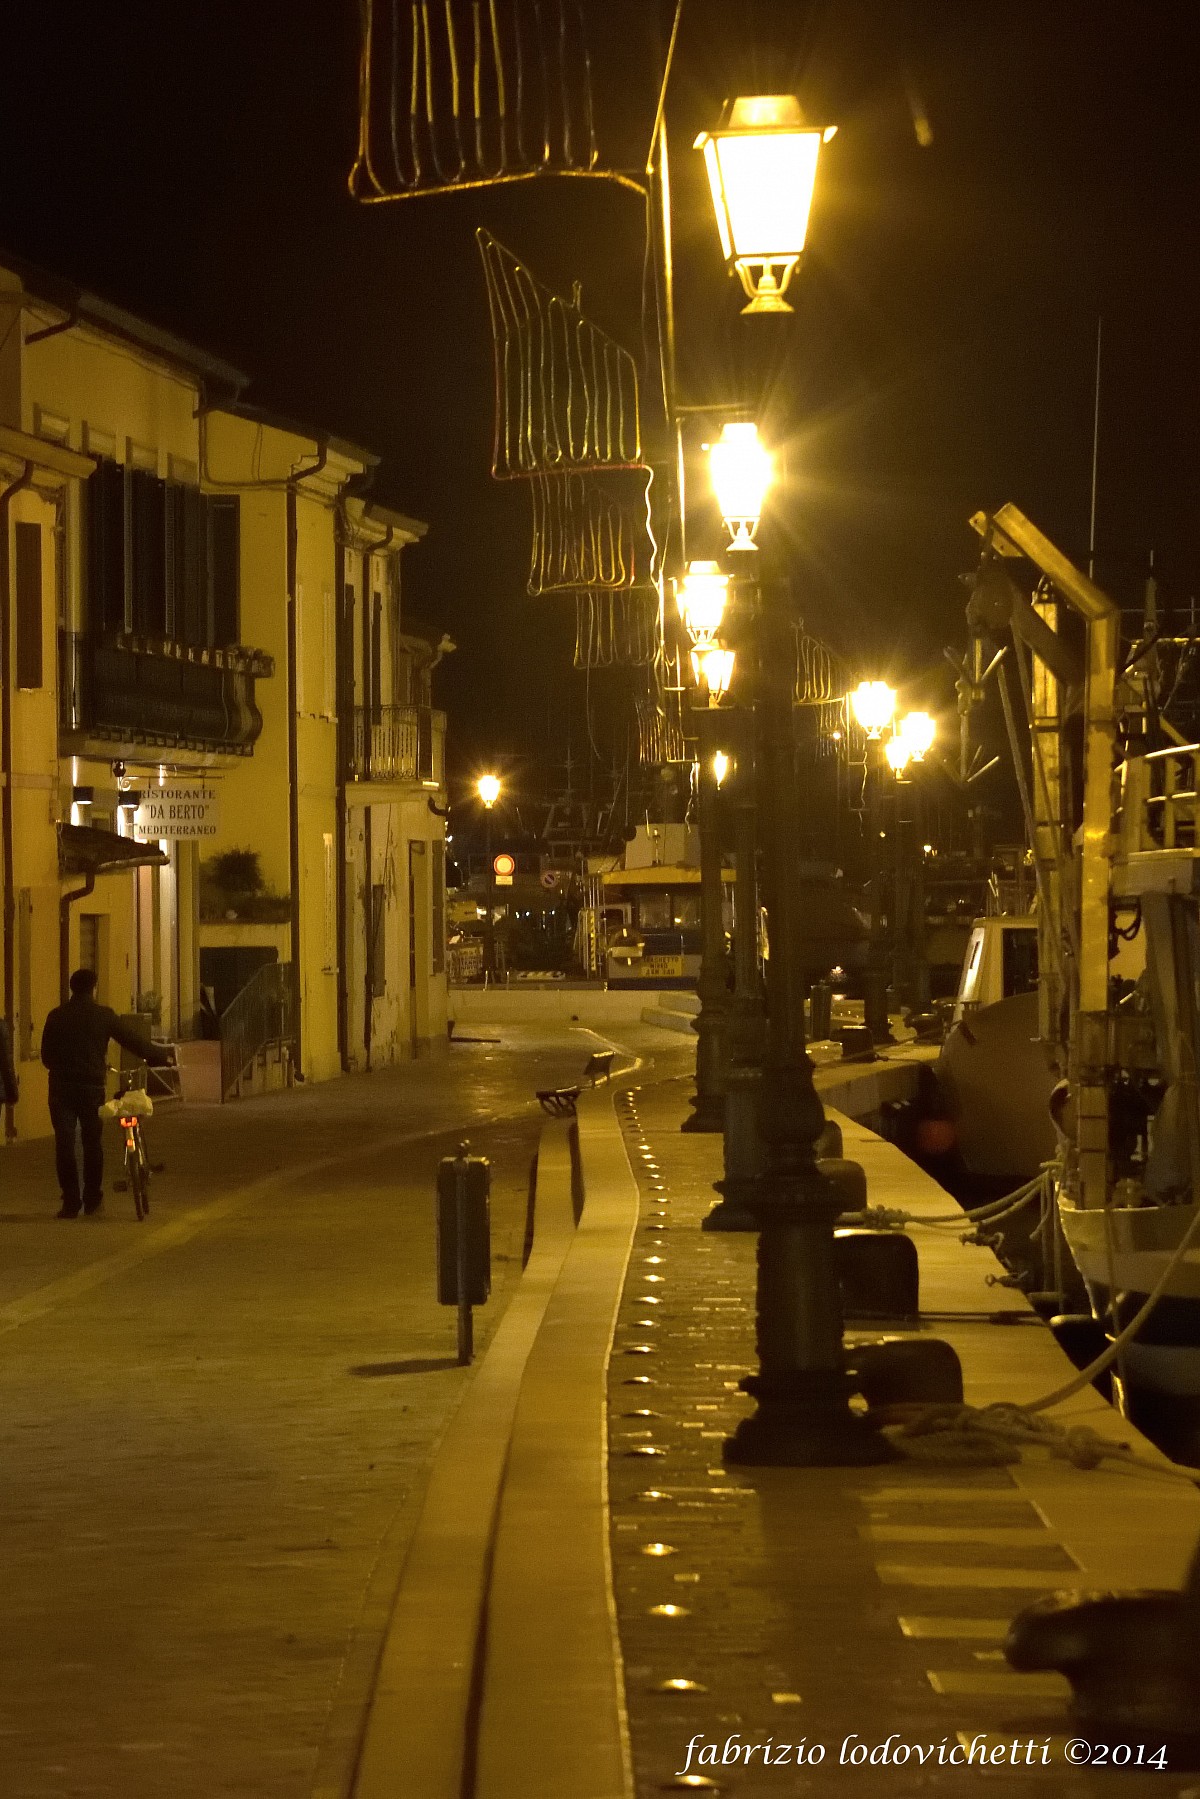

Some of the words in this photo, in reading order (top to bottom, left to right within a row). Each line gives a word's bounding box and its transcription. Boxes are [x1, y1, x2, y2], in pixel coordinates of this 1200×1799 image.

[140, 790, 216, 799] RISTORANTE
[145, 804, 165, 820] "DA
[169, 804, 210, 820] BERTO"
[140, 825, 216, 834] MEDITERRANEO
